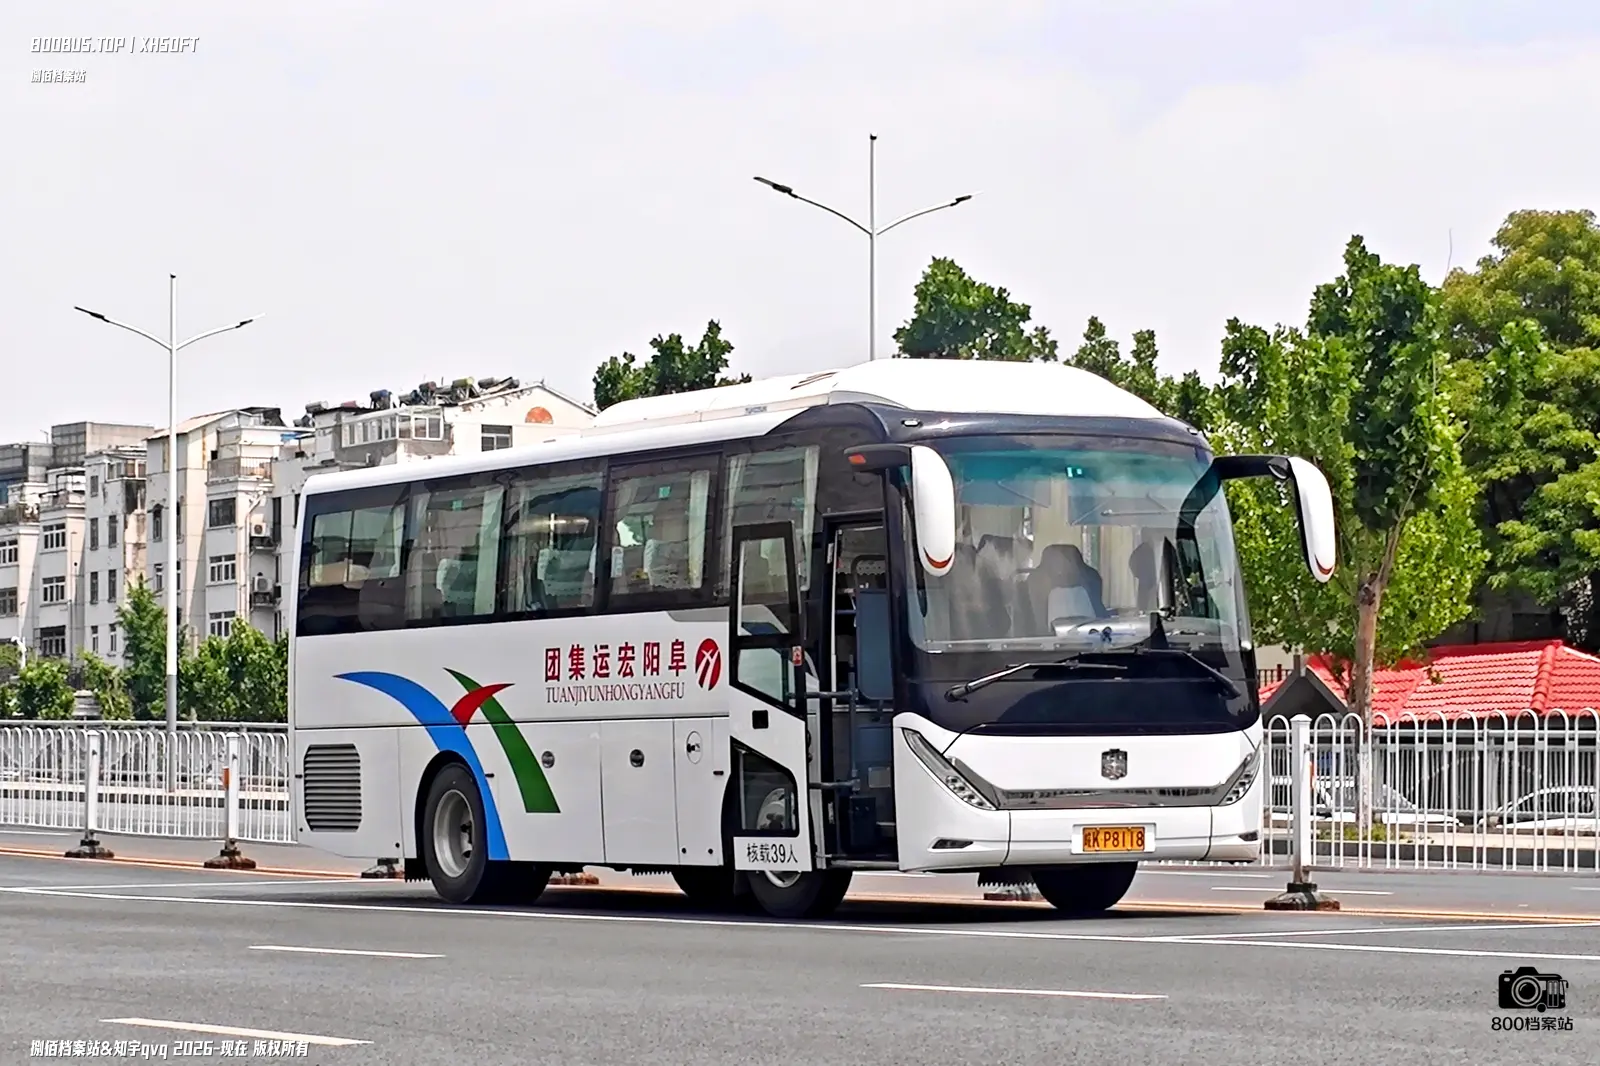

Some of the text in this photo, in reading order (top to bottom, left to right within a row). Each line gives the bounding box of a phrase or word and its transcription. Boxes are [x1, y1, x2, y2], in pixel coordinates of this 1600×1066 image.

[545, 682, 685, 706] TUANJIYUNHONGYANGFU
[746, 842, 799, 864] 核载39人
